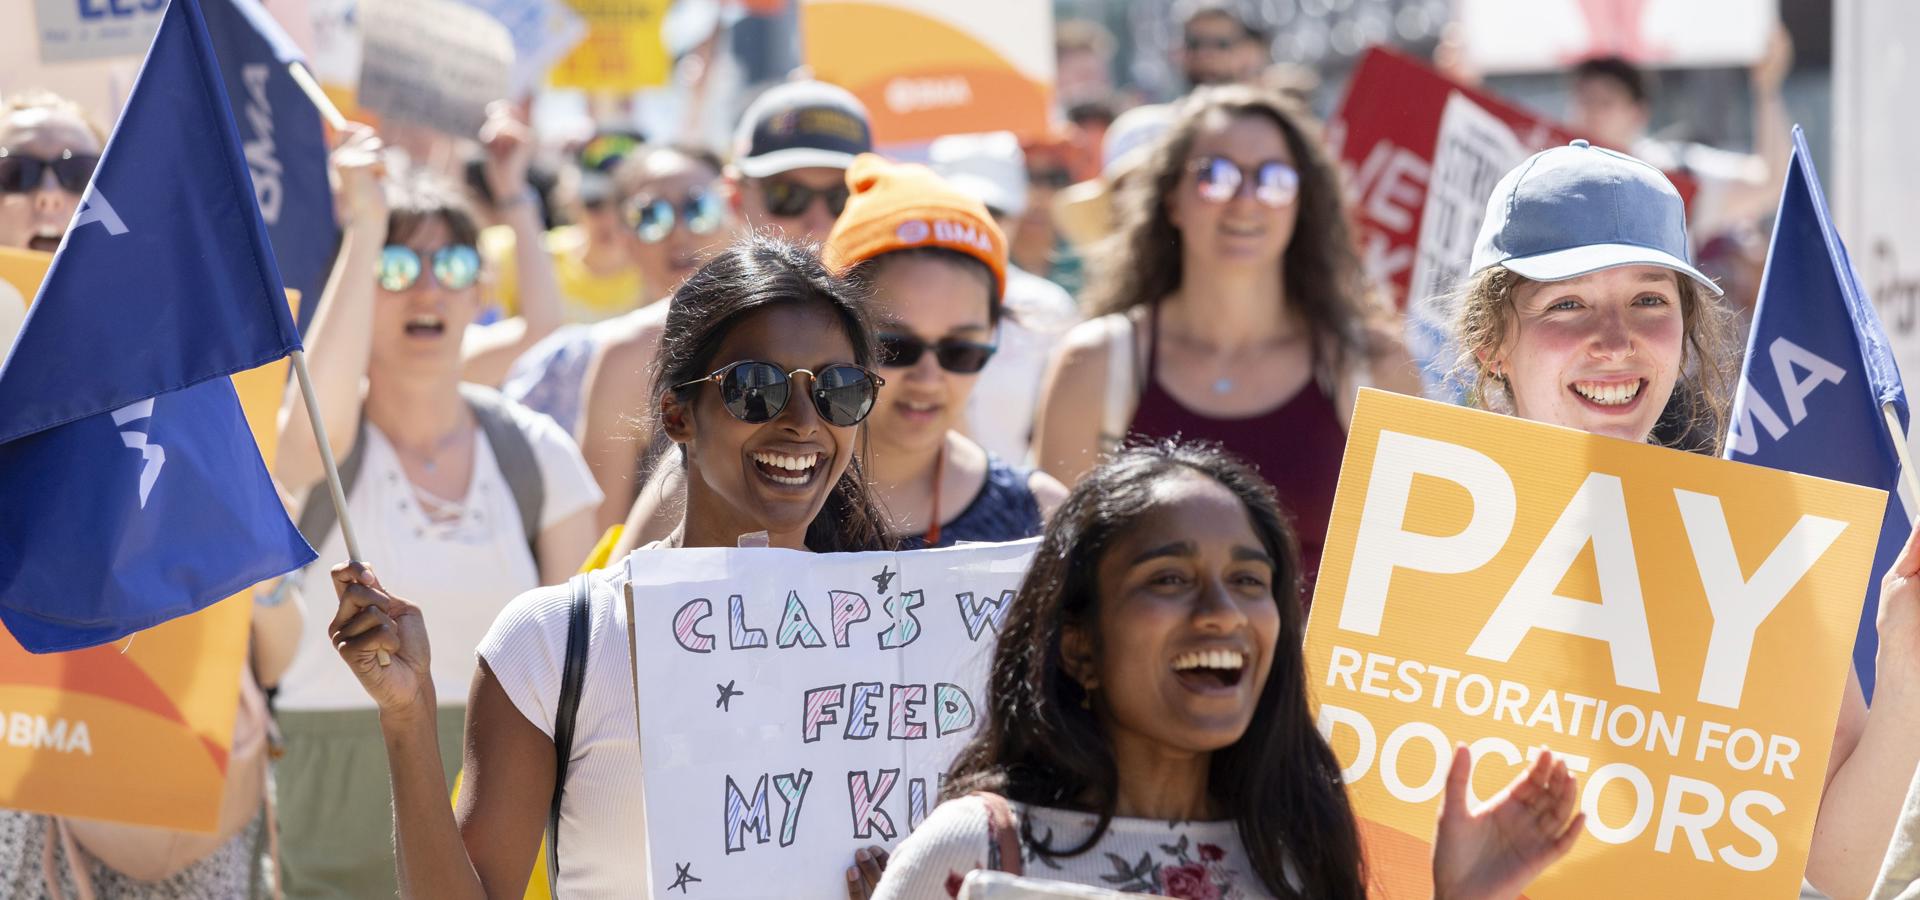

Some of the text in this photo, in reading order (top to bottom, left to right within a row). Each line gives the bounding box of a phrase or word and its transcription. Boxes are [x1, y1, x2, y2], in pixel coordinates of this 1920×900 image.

[934, 218, 993, 252] BMA
[1338, 429, 1850, 710] PAY
[8, 711, 93, 757] BMA
[803, 682, 976, 743] FEED
[1325, 646, 1801, 780] RESTORATION FOR
[725, 768, 947, 855] MY KI
